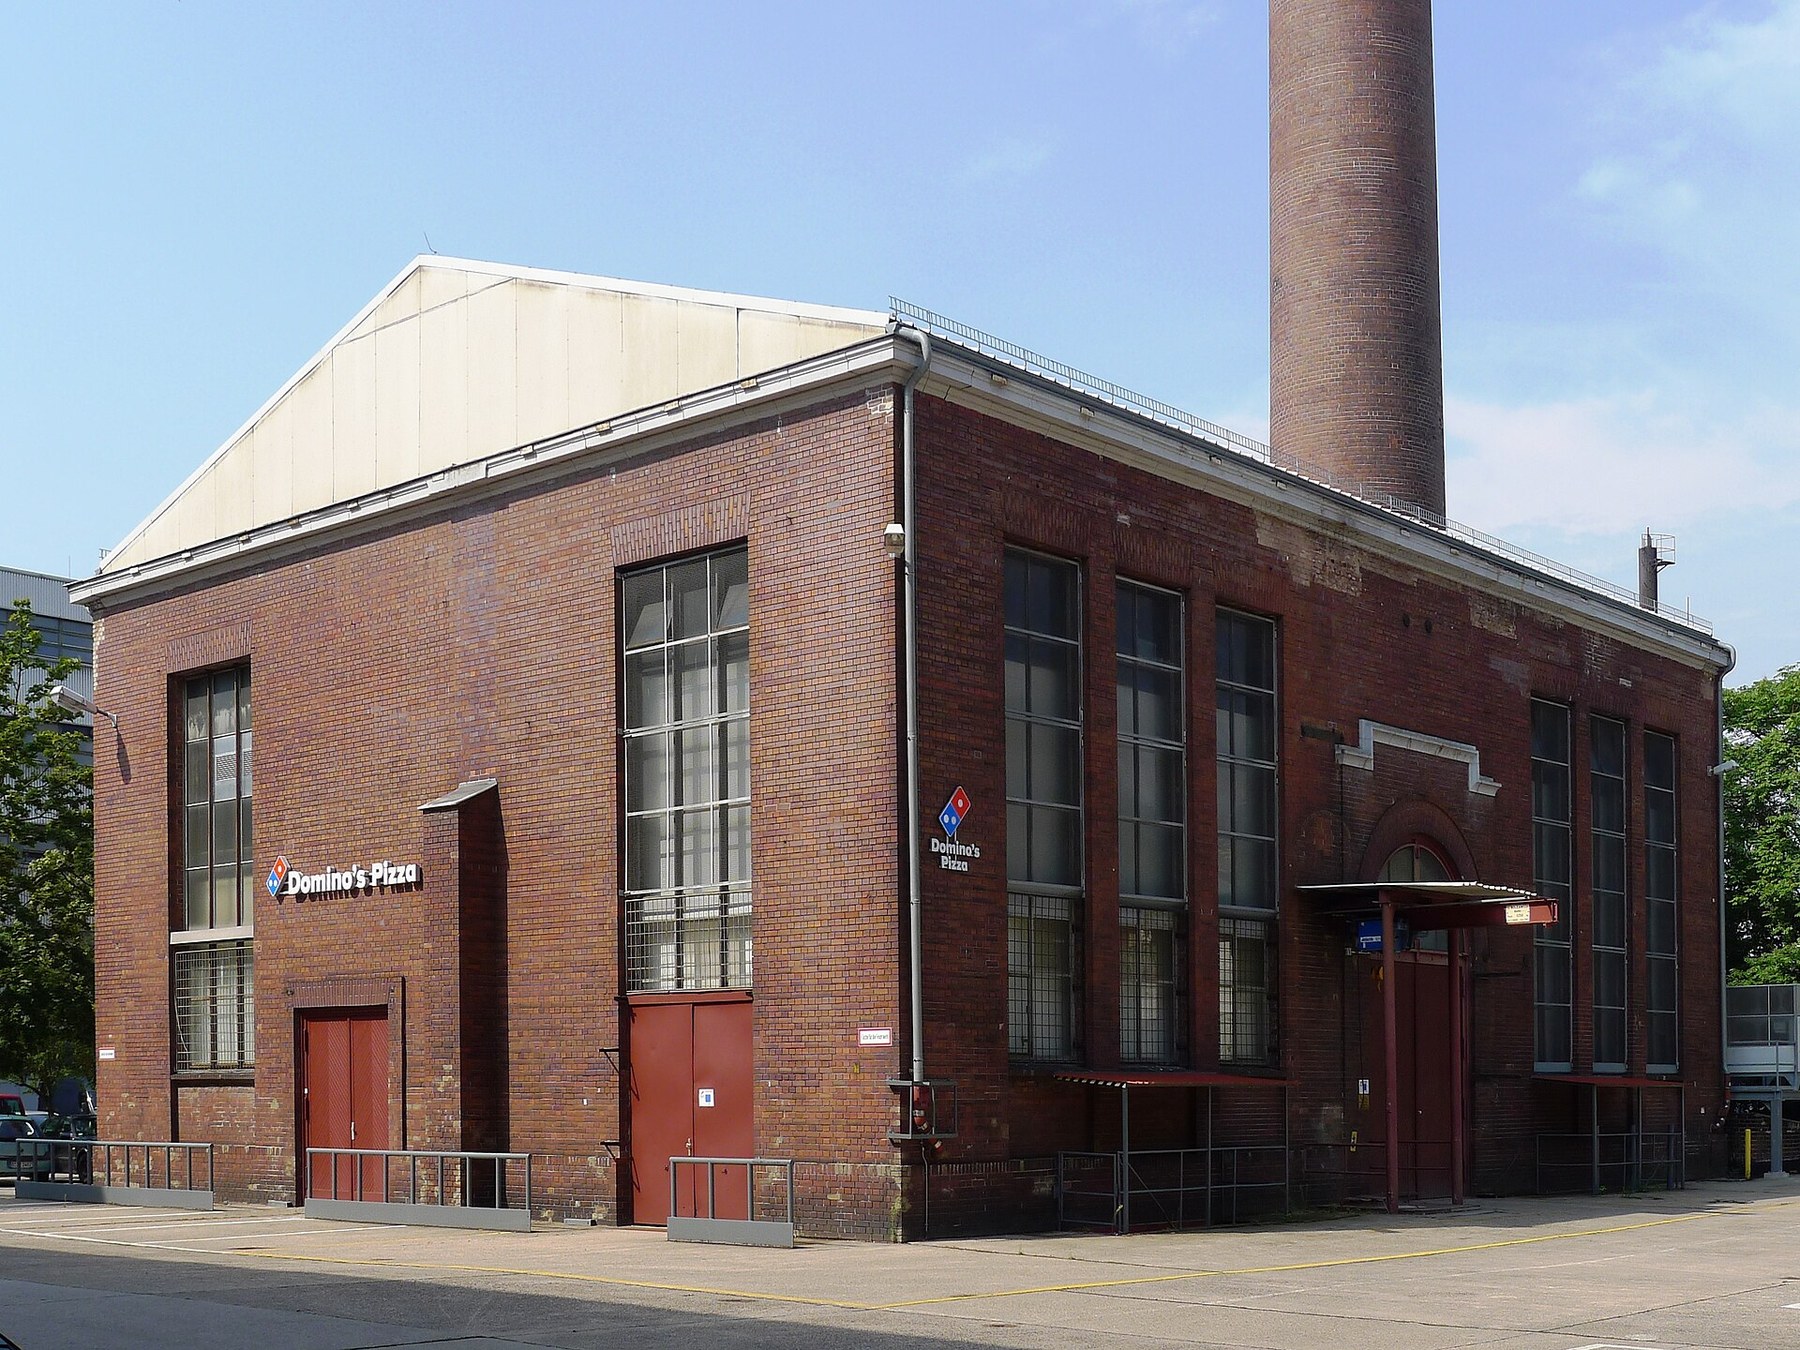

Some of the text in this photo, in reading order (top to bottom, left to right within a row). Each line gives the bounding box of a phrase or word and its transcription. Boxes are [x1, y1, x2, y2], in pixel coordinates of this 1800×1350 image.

[931, 838, 981, 858] Domino's
[941, 855, 968, 872] Pizza
[288, 860, 417, 895] Domino's Pizza
